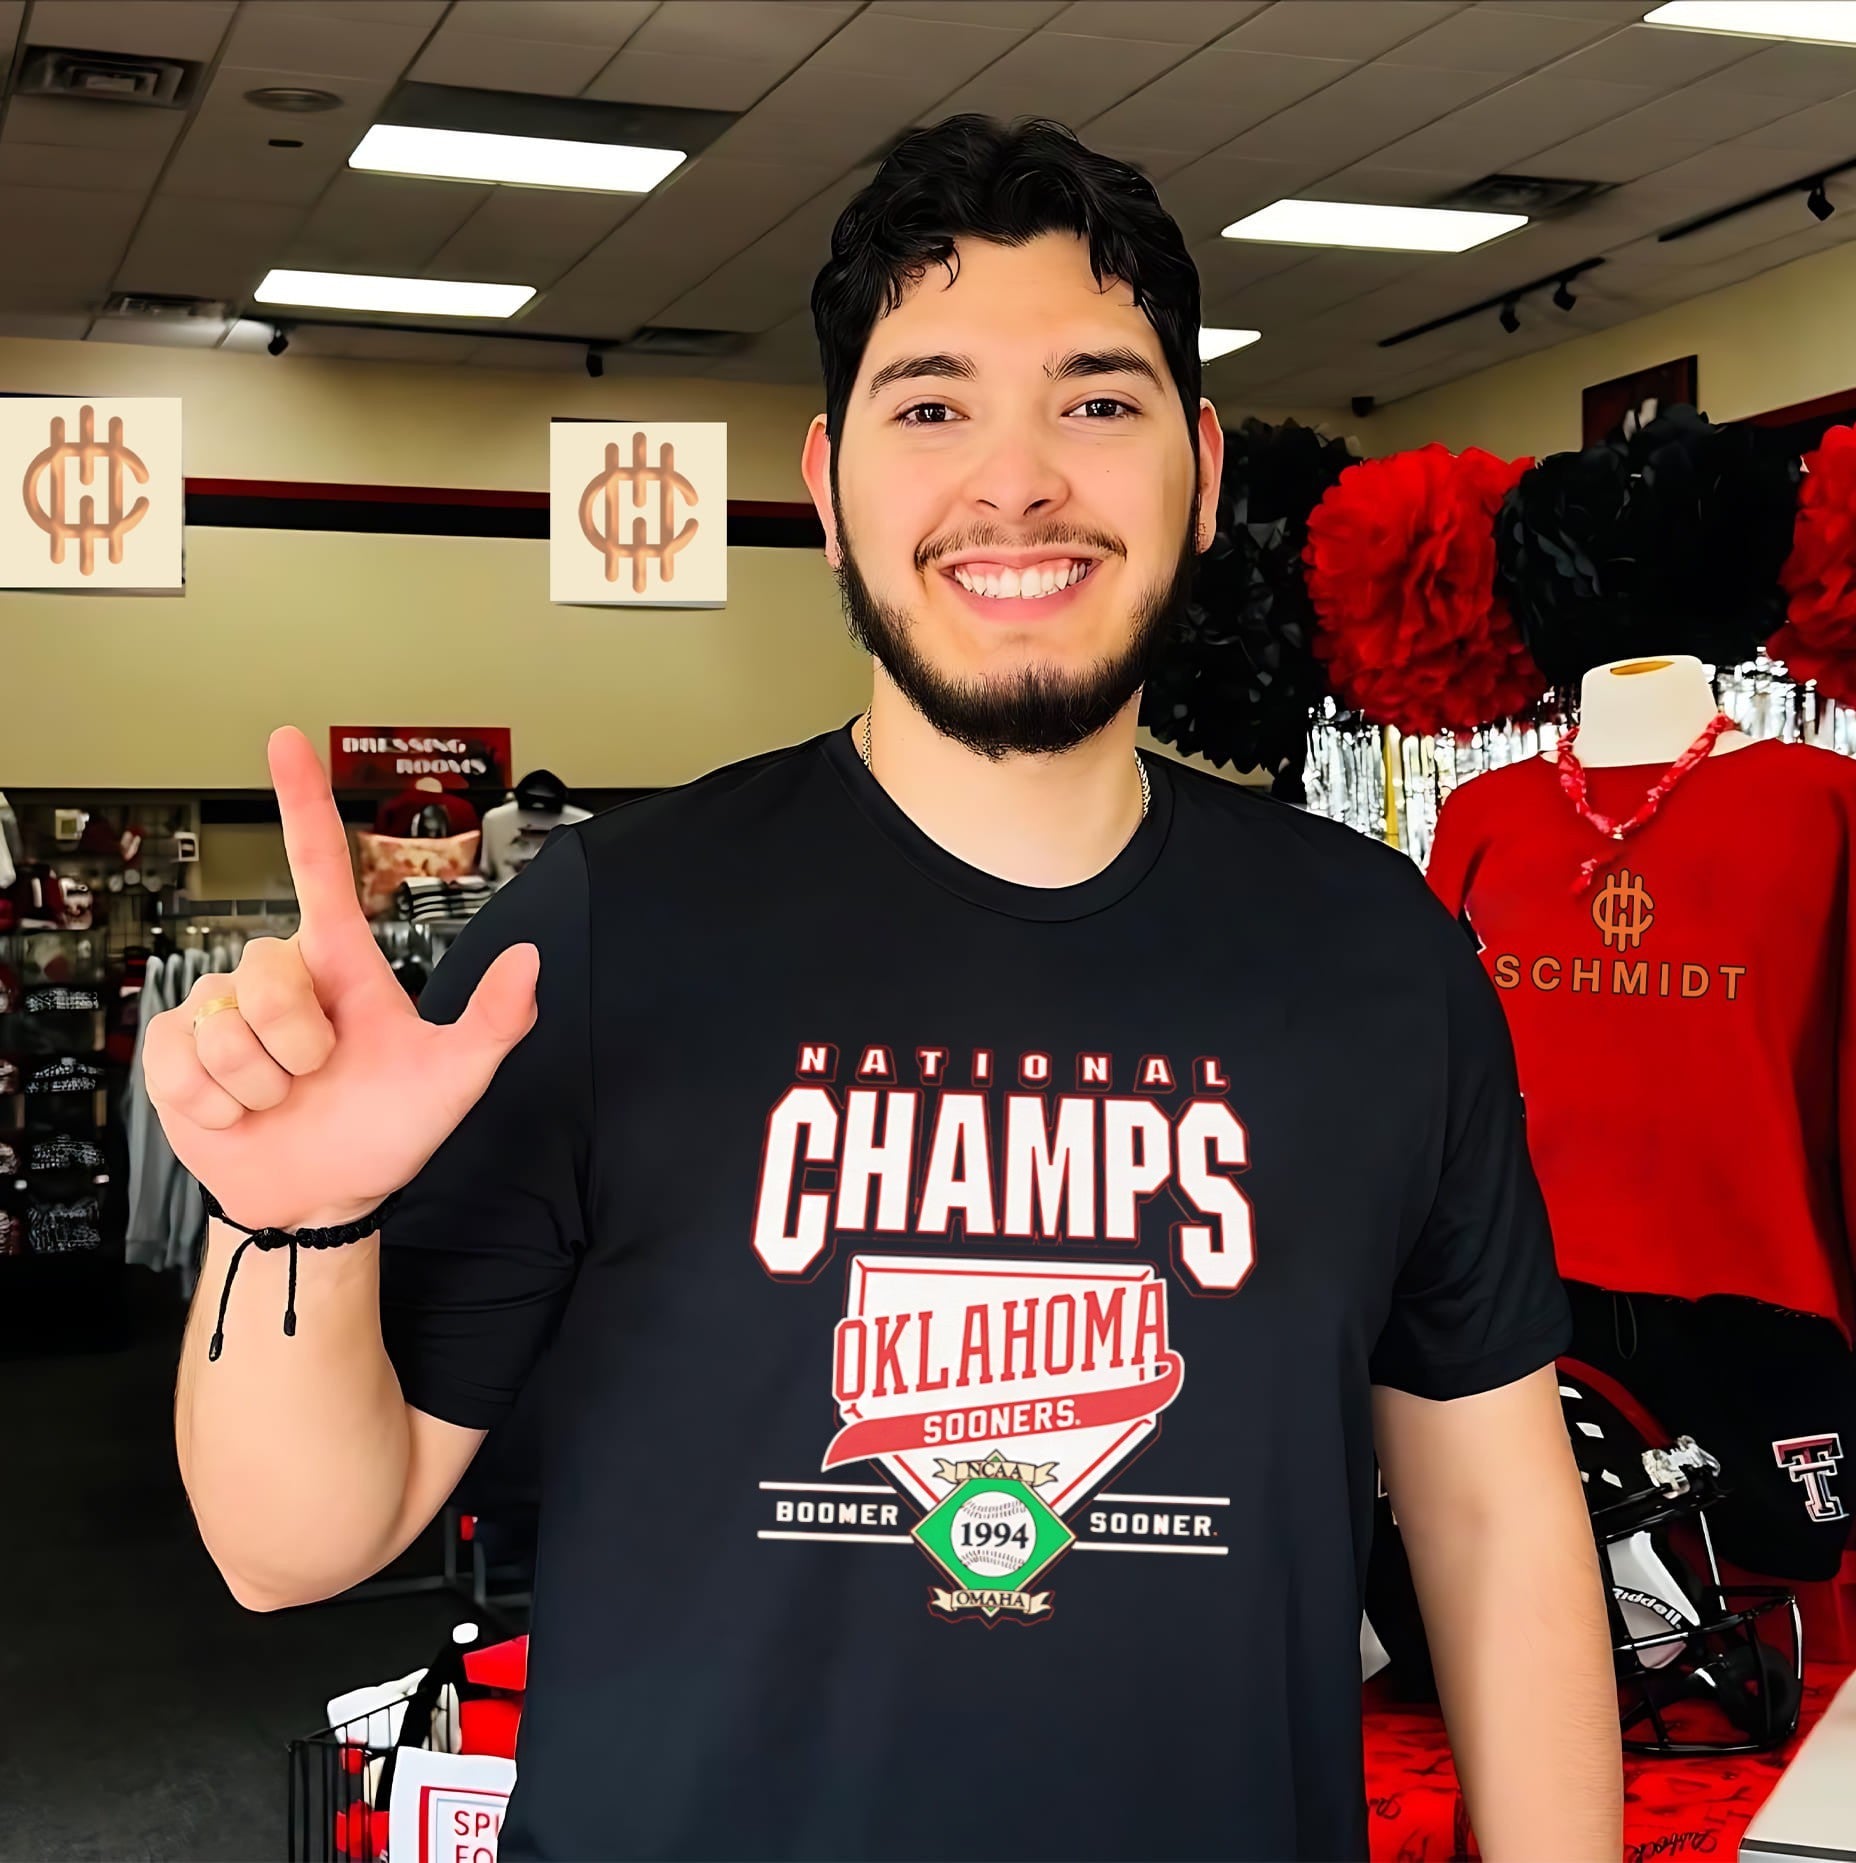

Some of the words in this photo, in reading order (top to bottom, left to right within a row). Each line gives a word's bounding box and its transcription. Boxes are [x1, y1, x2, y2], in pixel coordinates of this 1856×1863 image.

[1494, 954, 1746, 1000] SCHMIDT
[798, 1044, 1229, 1090] NATIONAL
[751, 1084, 1256, 1290] CHAMPS
[834, 1281, 1167, 1401] OKLAHOMA
[966, 1461, 1024, 1480] NCAA
[775, 1500, 899, 1526] BOOMER
[958, 1521, 1030, 1551] 1994
[955, 1590, 1026, 1609] OMAHA
